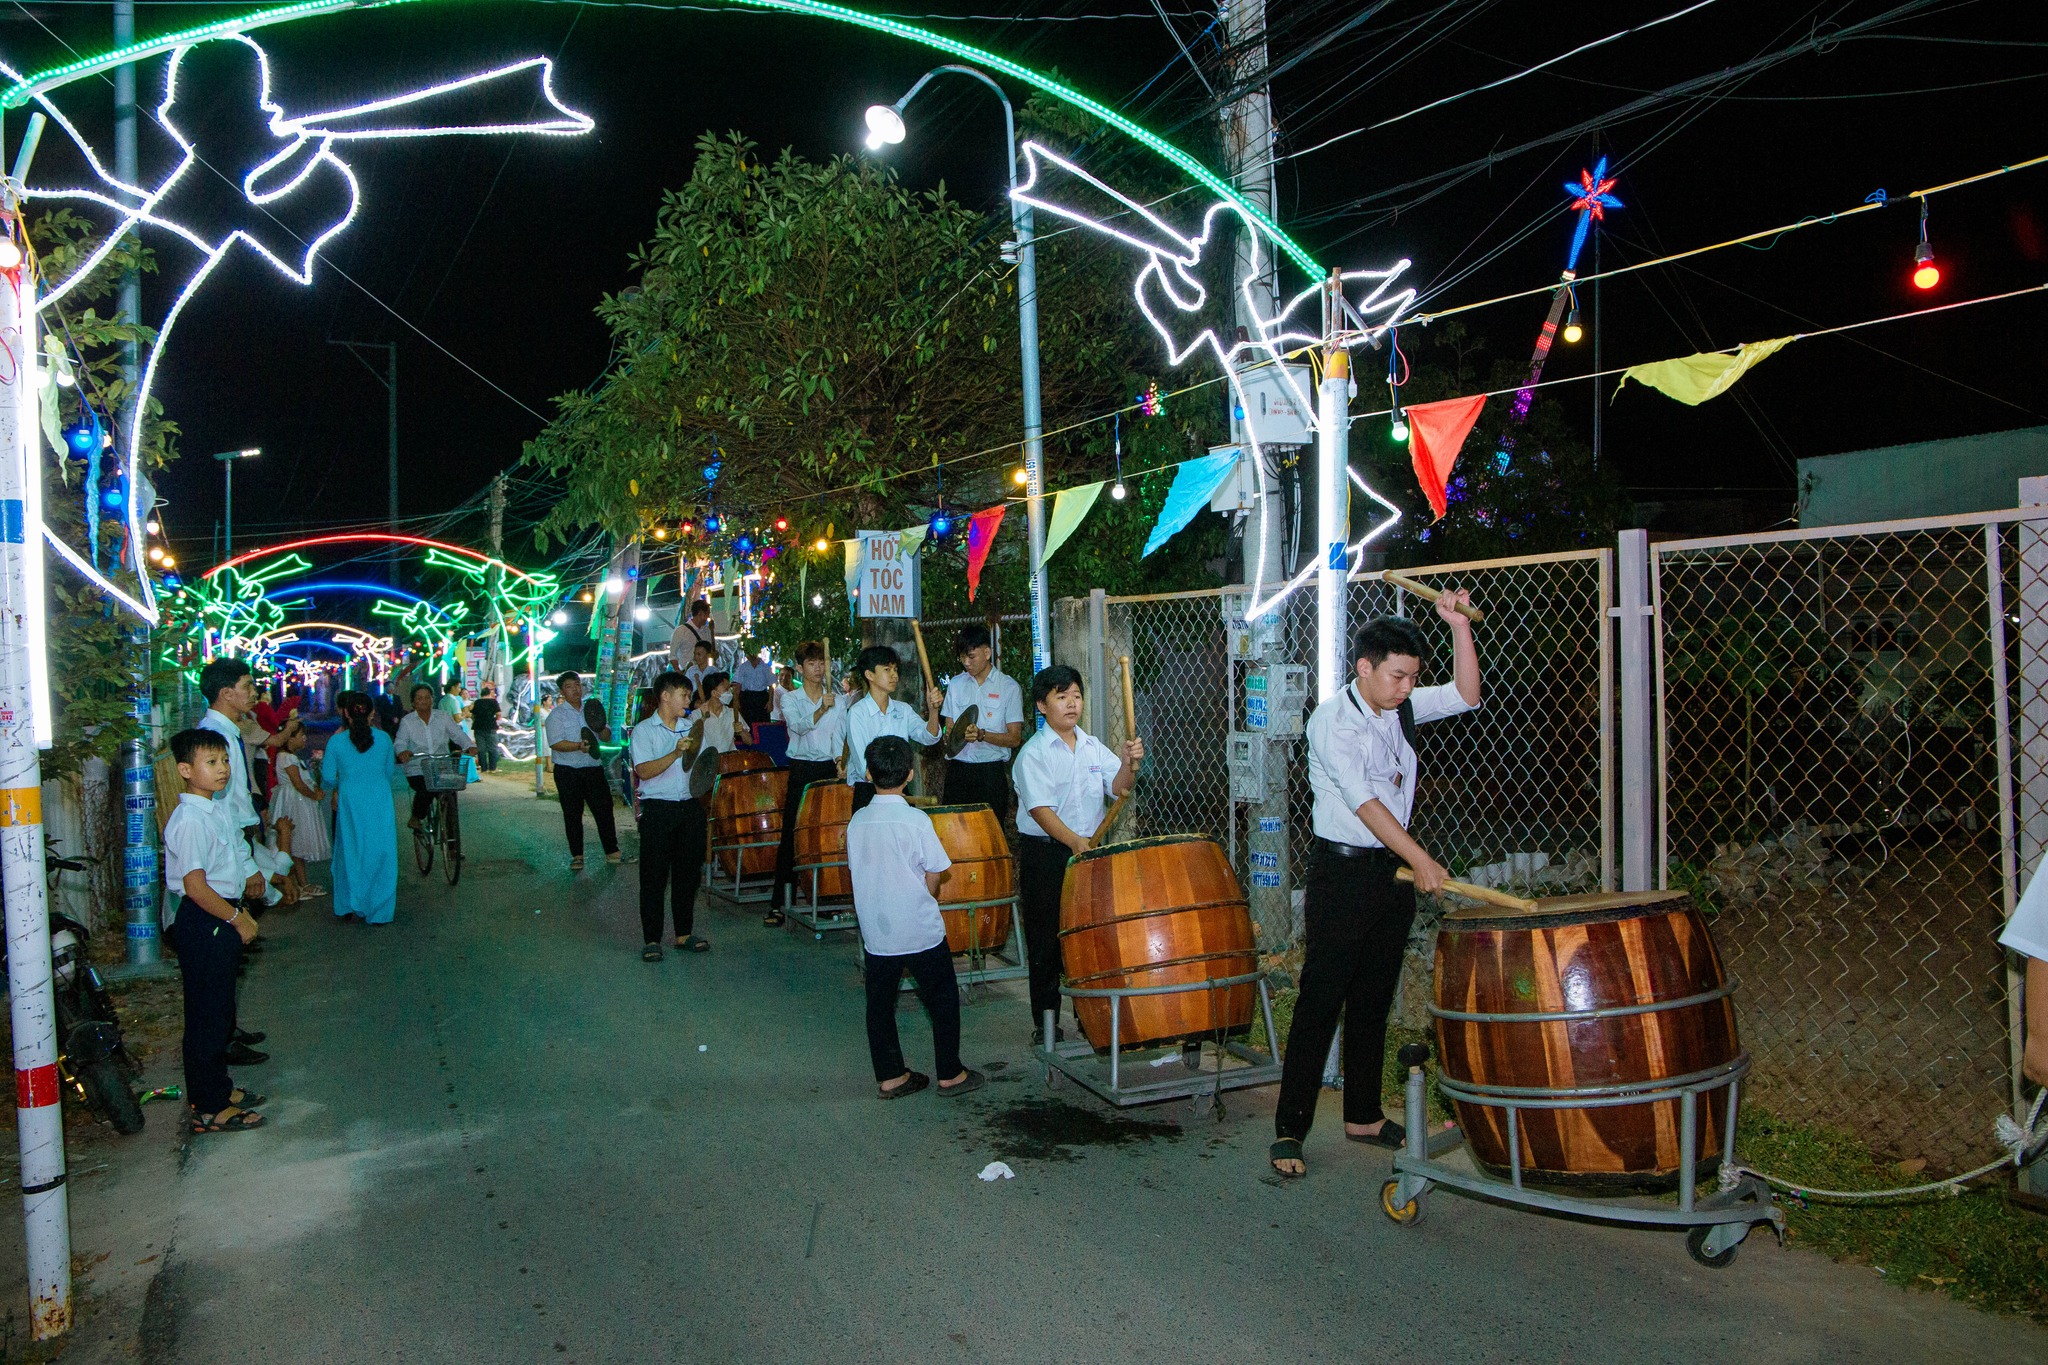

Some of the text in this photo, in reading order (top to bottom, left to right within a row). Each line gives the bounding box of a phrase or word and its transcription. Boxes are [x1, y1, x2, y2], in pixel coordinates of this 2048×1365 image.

[871, 534, 900, 561] HỚ
[870, 562, 903, 590] TÓC
[869, 594, 905, 615] NAM
